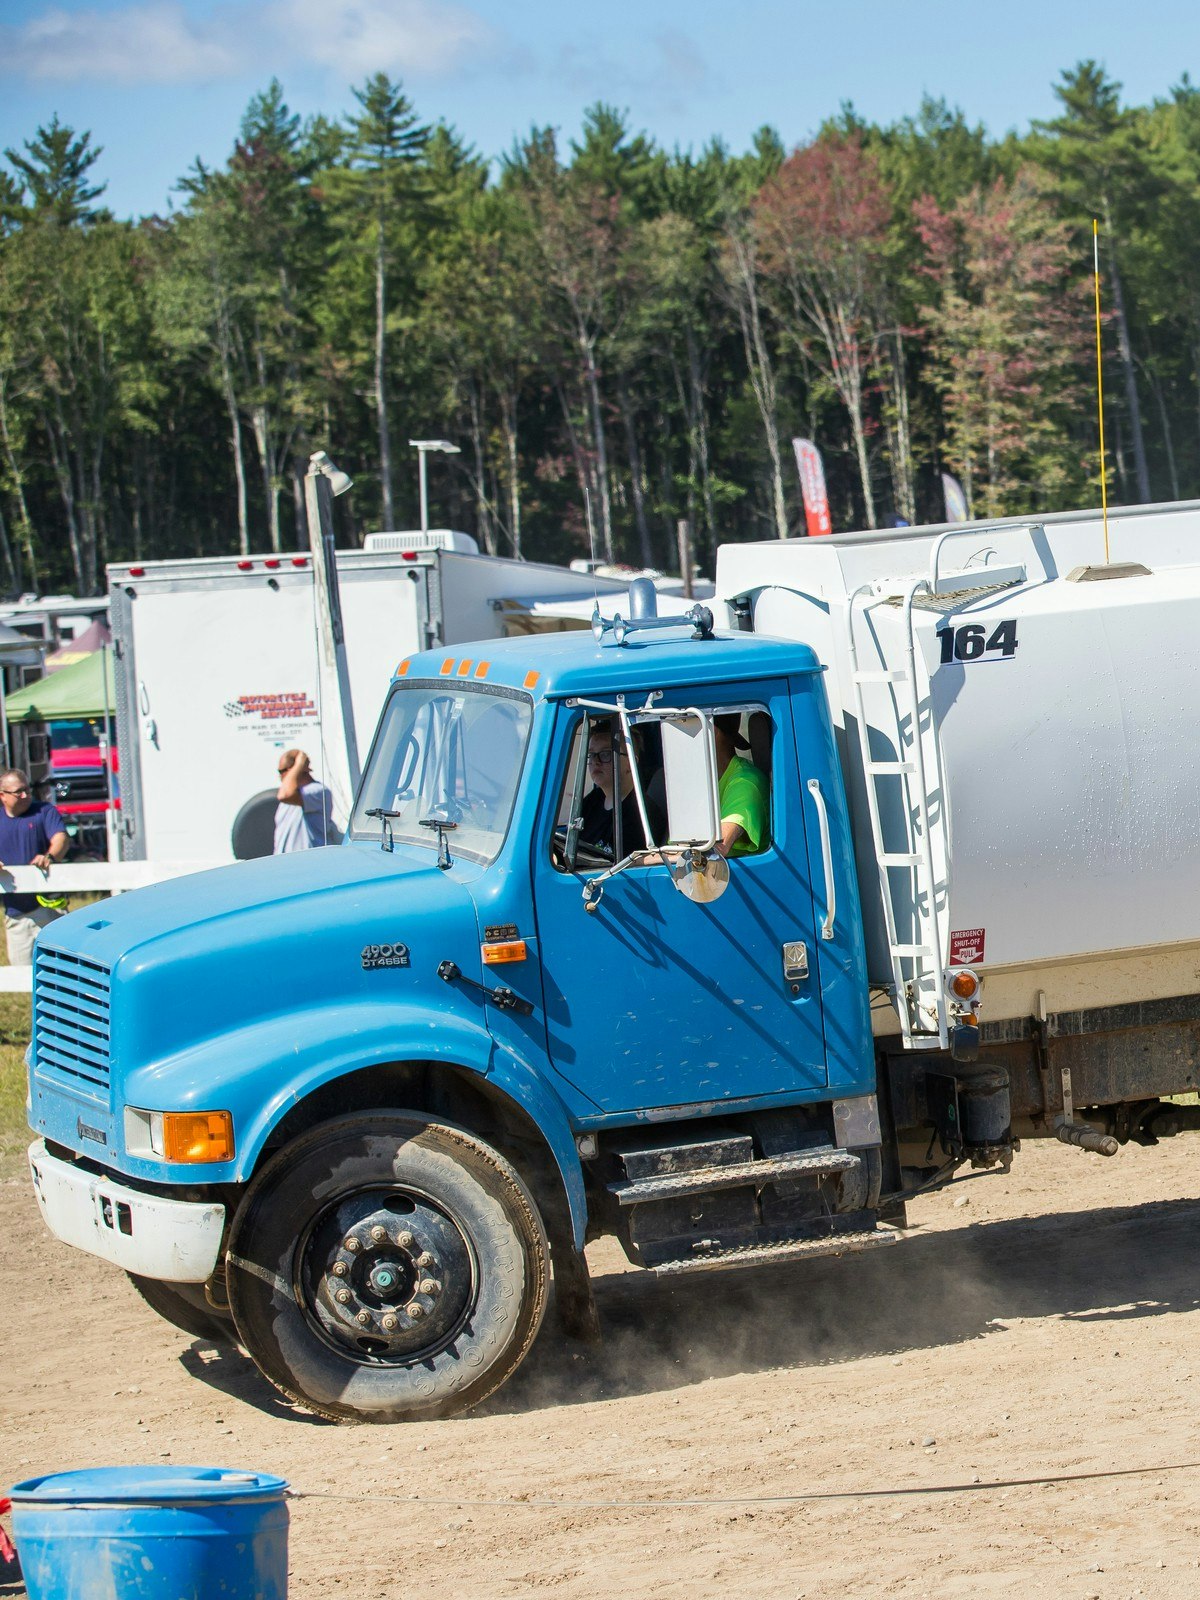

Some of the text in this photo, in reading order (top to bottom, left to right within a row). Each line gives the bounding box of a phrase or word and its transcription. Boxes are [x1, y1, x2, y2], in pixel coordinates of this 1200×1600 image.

[936, 620, 1018, 664] 164
[239, 693, 306, 703] MOTORCYCLE
[261, 709, 303, 719] SERVICE
[952, 930, 984, 939] EMERGENCY
[954, 938, 981, 948] SHUT-OFF
[361, 942, 406, 959] 4900
[960, 949, 974, 958] PULL
[362, 957, 407, 967] DT466E
